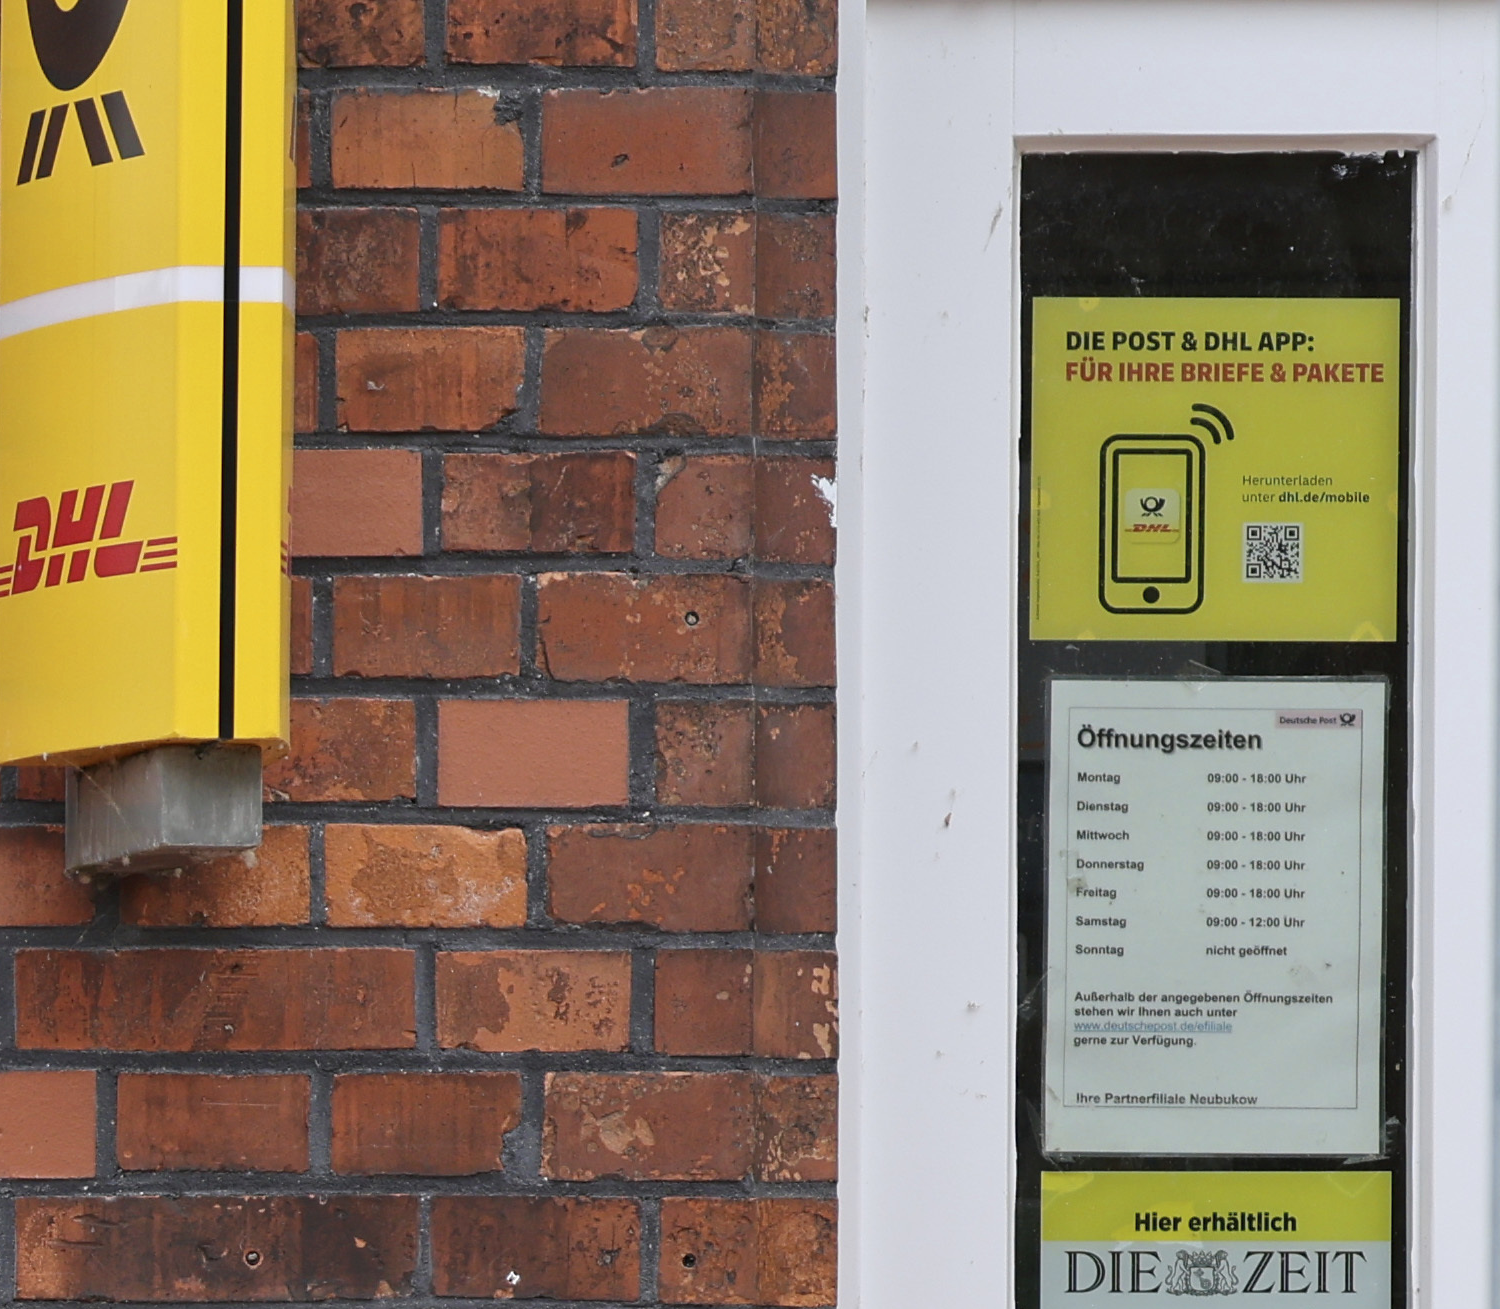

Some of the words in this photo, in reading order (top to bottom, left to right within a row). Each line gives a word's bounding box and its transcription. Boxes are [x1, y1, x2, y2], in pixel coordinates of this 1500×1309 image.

[1066, 331, 1106, 351] DIE
[1112, 331, 1176, 352] POST
[1180, 331, 1198, 352] &
[1204, 331, 1253, 352] DHL
[1257, 331, 1315, 352] APP:
[1065, 356, 1113, 383] FÜR
[1118, 361, 1175, 383] IHRE
[1180, 362, 1265, 383] BRIEFE
[1269, 362, 1287, 383] &
[1292, 362, 1385, 383] PAKETE
[1242, 474, 1333, 487] Herunterladen
[1242, 492, 1276, 503] unter
[1278, 491, 1370, 503] dhl.de/mobile
[1132, 523, 1172, 533] DHL
[8, 480, 150, 597] DHL
[1279, 716, 1317, 725] Deutsche
[1318, 716, 1337, 725] Post
[1077, 723, 1262, 755] Öffnungszeiten
[1077, 771, 1121, 785] Montag
[1207, 772, 1239, 784] 09:00
[1250, 773, 1282, 784] 18:00
[1284, 773, 1307, 784] Uhr
[1076, 800, 1129, 814] Dienstag
[1206, 801, 1239, 813] 09:00
[1250, 802, 1282, 813] 18:00
[1284, 802, 1307, 813] Uhr
[1076, 829, 1130, 841] Mittwoch
[1206, 830, 1239, 842] 09:00
[1250, 831, 1281, 842] 18:00
[1284, 831, 1306, 842] Uhr
[1076, 858, 1145, 872] Donnerstag
[1206, 859, 1239, 870] 09:00
[1249, 859, 1281, 871] 18:00
[1284, 860, 1305, 871] Uhr
[1075, 887, 1117, 900] Freitag
[1206, 887, 1238, 899] 09:00
[1249, 888, 1281, 899] 18:00
[1283, 888, 1306, 899] Uhr
[1075, 915, 1127, 929] Samstag
[1205, 916, 1238, 928] 09:00
[1248, 916, 1281, 928] 12:00
[1283, 916, 1305, 928] Uhr
[1075, 943, 1125, 958] Sonntag
[1205, 945, 1236, 956] nicht
[1238, 945, 1288, 958] geöffnet
[1074, 991, 1135, 1002] Außerhalb
[1138, 991, 1158, 1003] der
[1160, 992, 1241, 1005] angegebenen
[1243, 990, 1333, 1006] Öffnungszeiten
[1074, 1006, 1114, 1017] stehen
[1116, 1006, 1135, 1017] wir
[1138, 1006, 1171, 1017] Ihnen
[1174, 1007, 1204, 1017] auch
[1206, 1007, 1238, 1018] unter
[1073, 1020, 1233, 1034] www.deutschepost.de/efiliale
[1073, 1036, 1108, 1048] gerne
[1110, 1037, 1130, 1046] zur
[1132, 1036, 1197, 1049] Verfügung.
[1076, 1092, 1101, 1104] Ihre
[1104, 1092, 1186, 1105] Partnerfiliale
[1189, 1093, 1258, 1105] Neubukow
[1134, 1211, 1182, 1232] Hier
[1188, 1211, 1297, 1232] erhältlich
[1064, 1250, 1161, 1294] DIE
[1241, 1250, 1367, 1294] ZEIT
